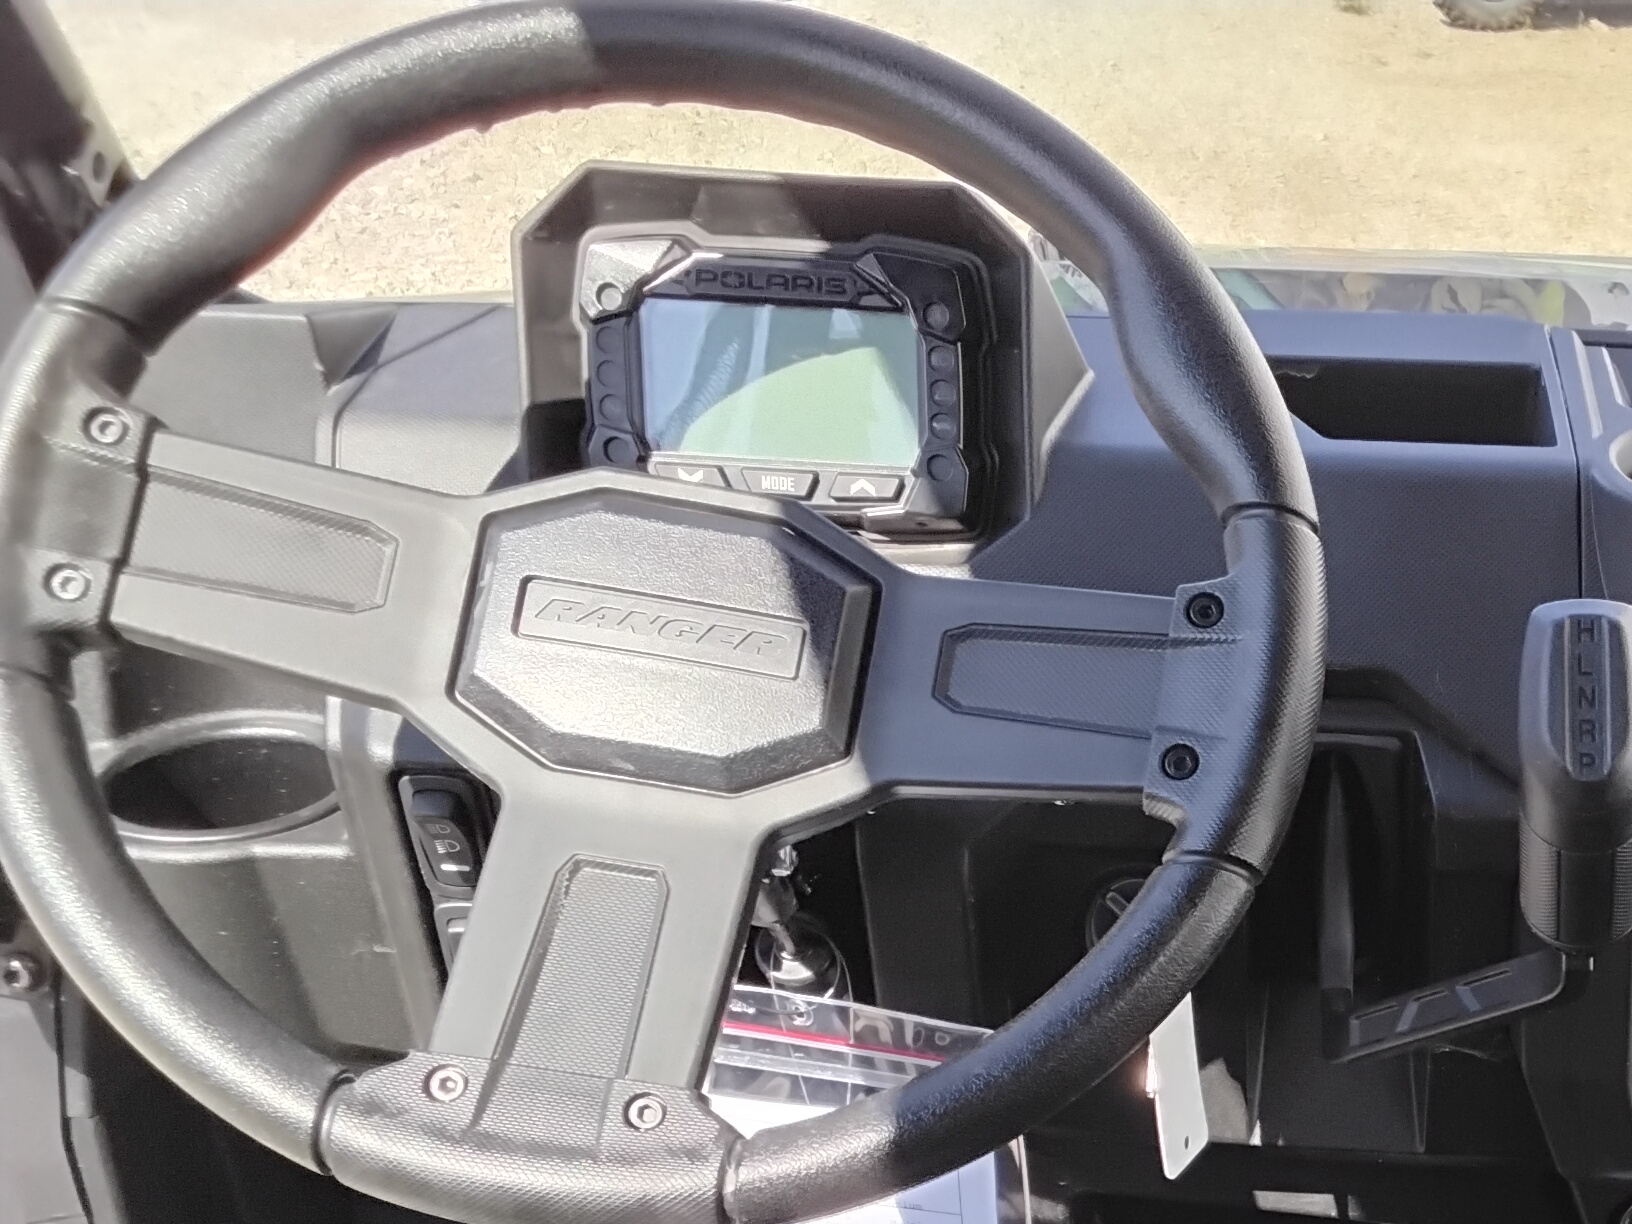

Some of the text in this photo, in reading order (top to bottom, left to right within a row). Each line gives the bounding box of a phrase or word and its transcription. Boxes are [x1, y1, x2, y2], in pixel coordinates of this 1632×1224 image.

[696, 268, 847, 295] POLARIS
[761, 475, 795, 491] MODE
[534, 598, 789, 655] RANGER
[1578, 620, 1595, 642] H
[1578, 652, 1593, 676] L
[1579, 686, 1596, 709] N
[1579, 719, 1596, 742] R
[1579, 753, 1596, 769] P
